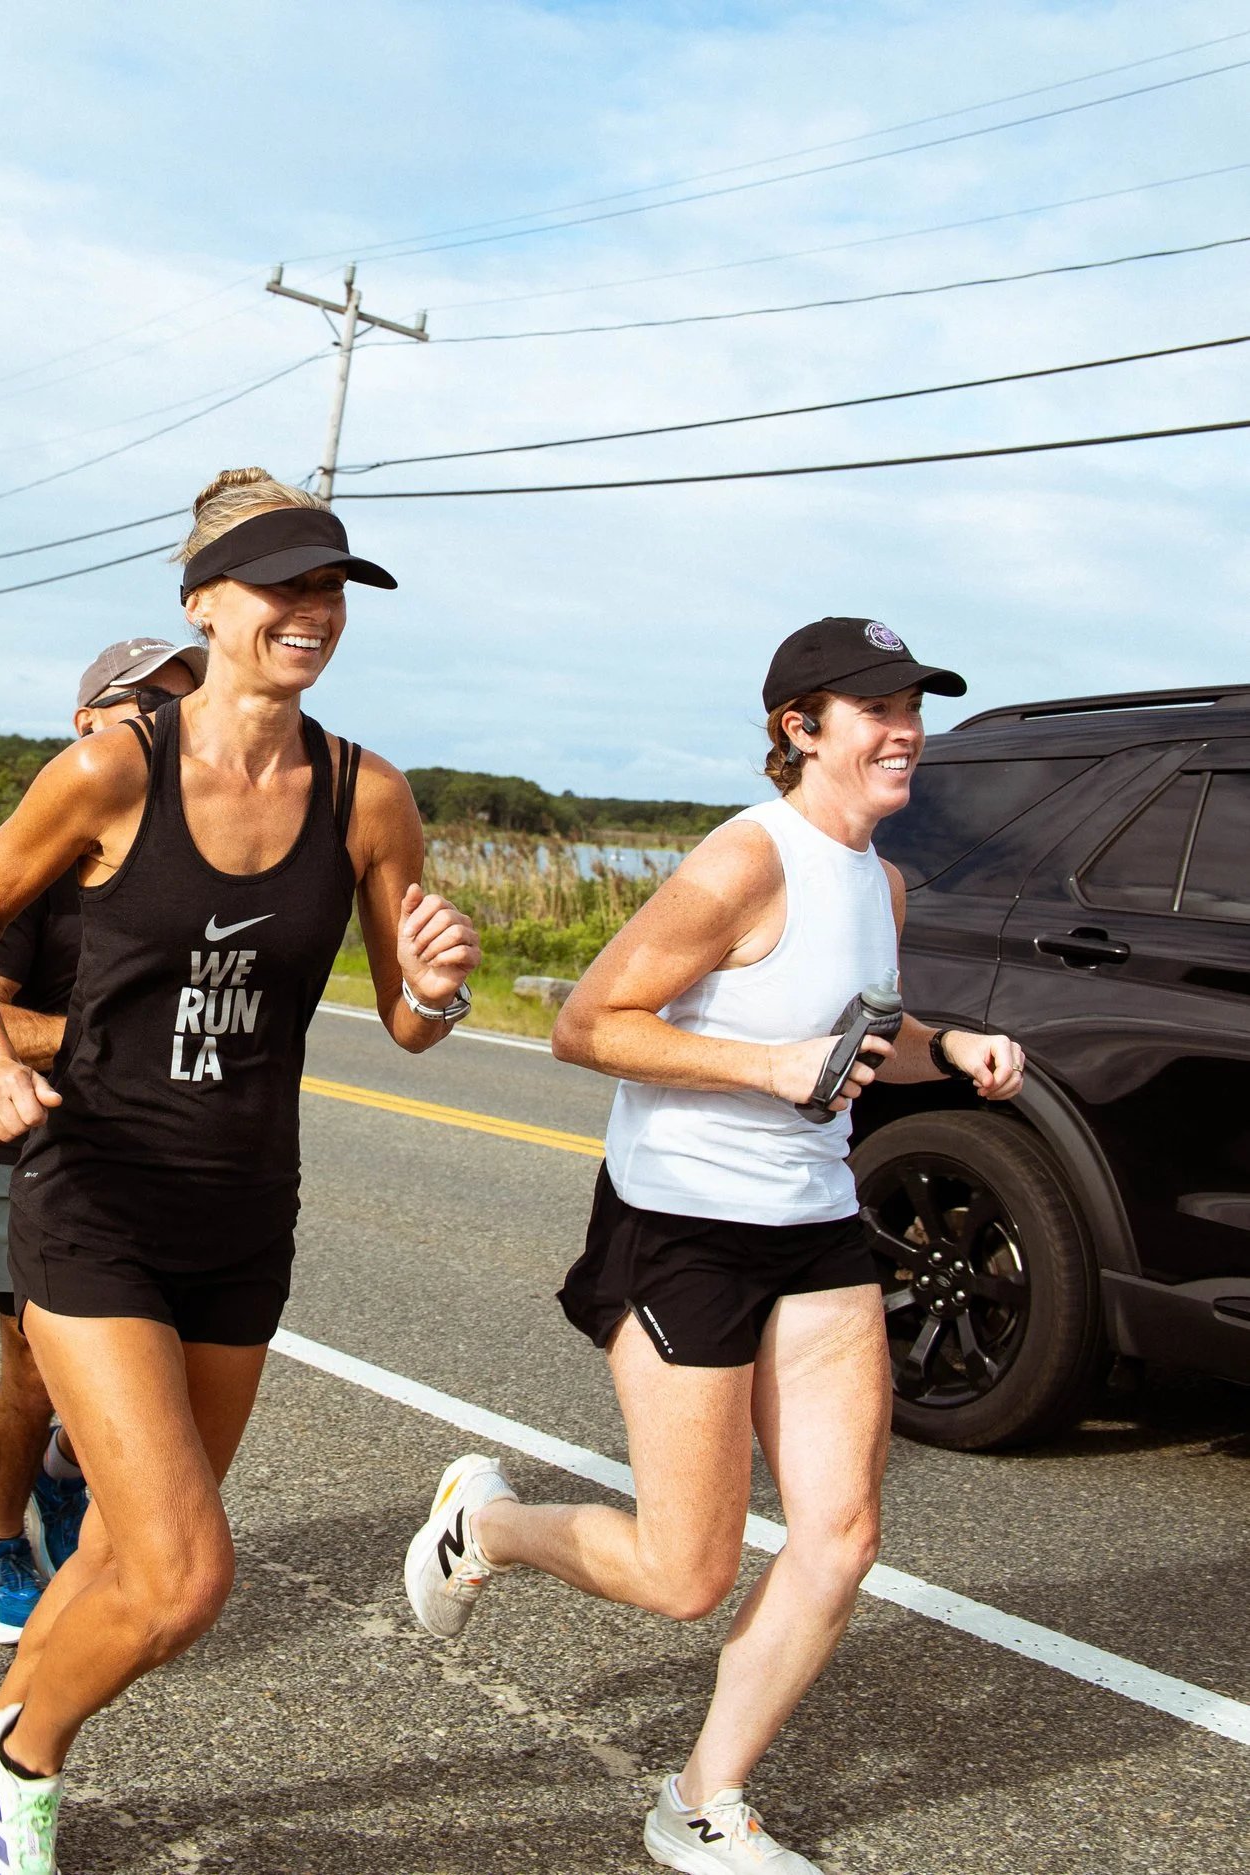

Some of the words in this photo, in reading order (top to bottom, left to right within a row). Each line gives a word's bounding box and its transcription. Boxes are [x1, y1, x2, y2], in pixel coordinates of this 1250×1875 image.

[190, 950, 257, 987] WE
[174, 986, 264, 1034] RUN
[170, 1035, 223, 1082] LA
